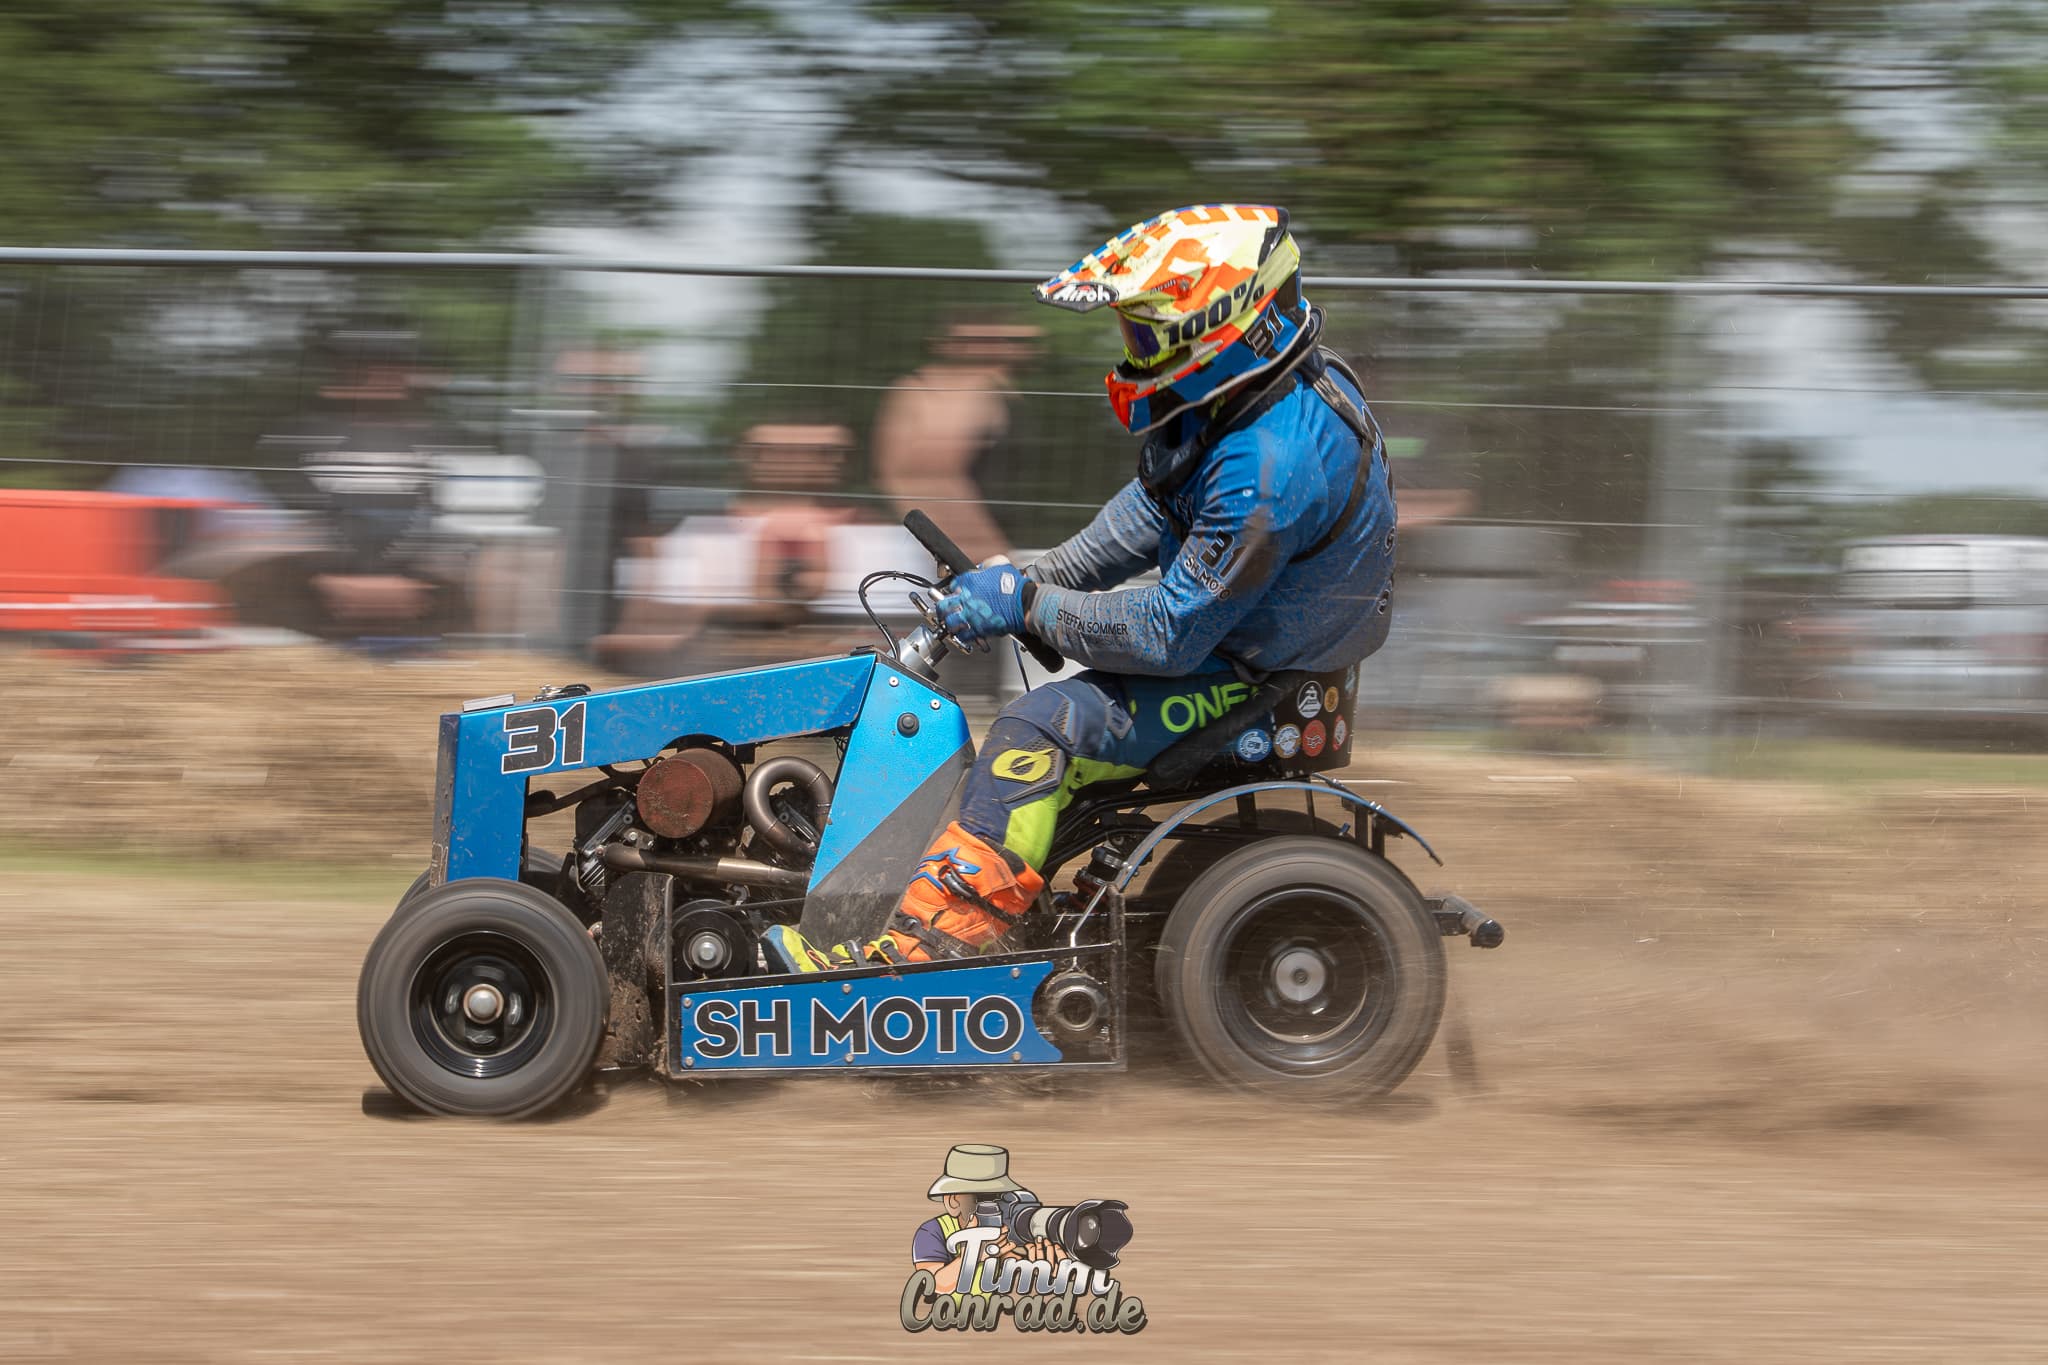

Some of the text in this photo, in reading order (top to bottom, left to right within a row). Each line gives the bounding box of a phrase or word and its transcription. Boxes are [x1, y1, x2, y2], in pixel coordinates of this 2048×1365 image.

[1163, 273, 1265, 347] 100%
[1245, 301, 1285, 361] 31
[1199, 526, 1248, 578] 31
[1086, 621, 1129, 635] SOMMER
[501, 701, 587, 775] 31
[693, 995, 1025, 1058] SH MOTO
